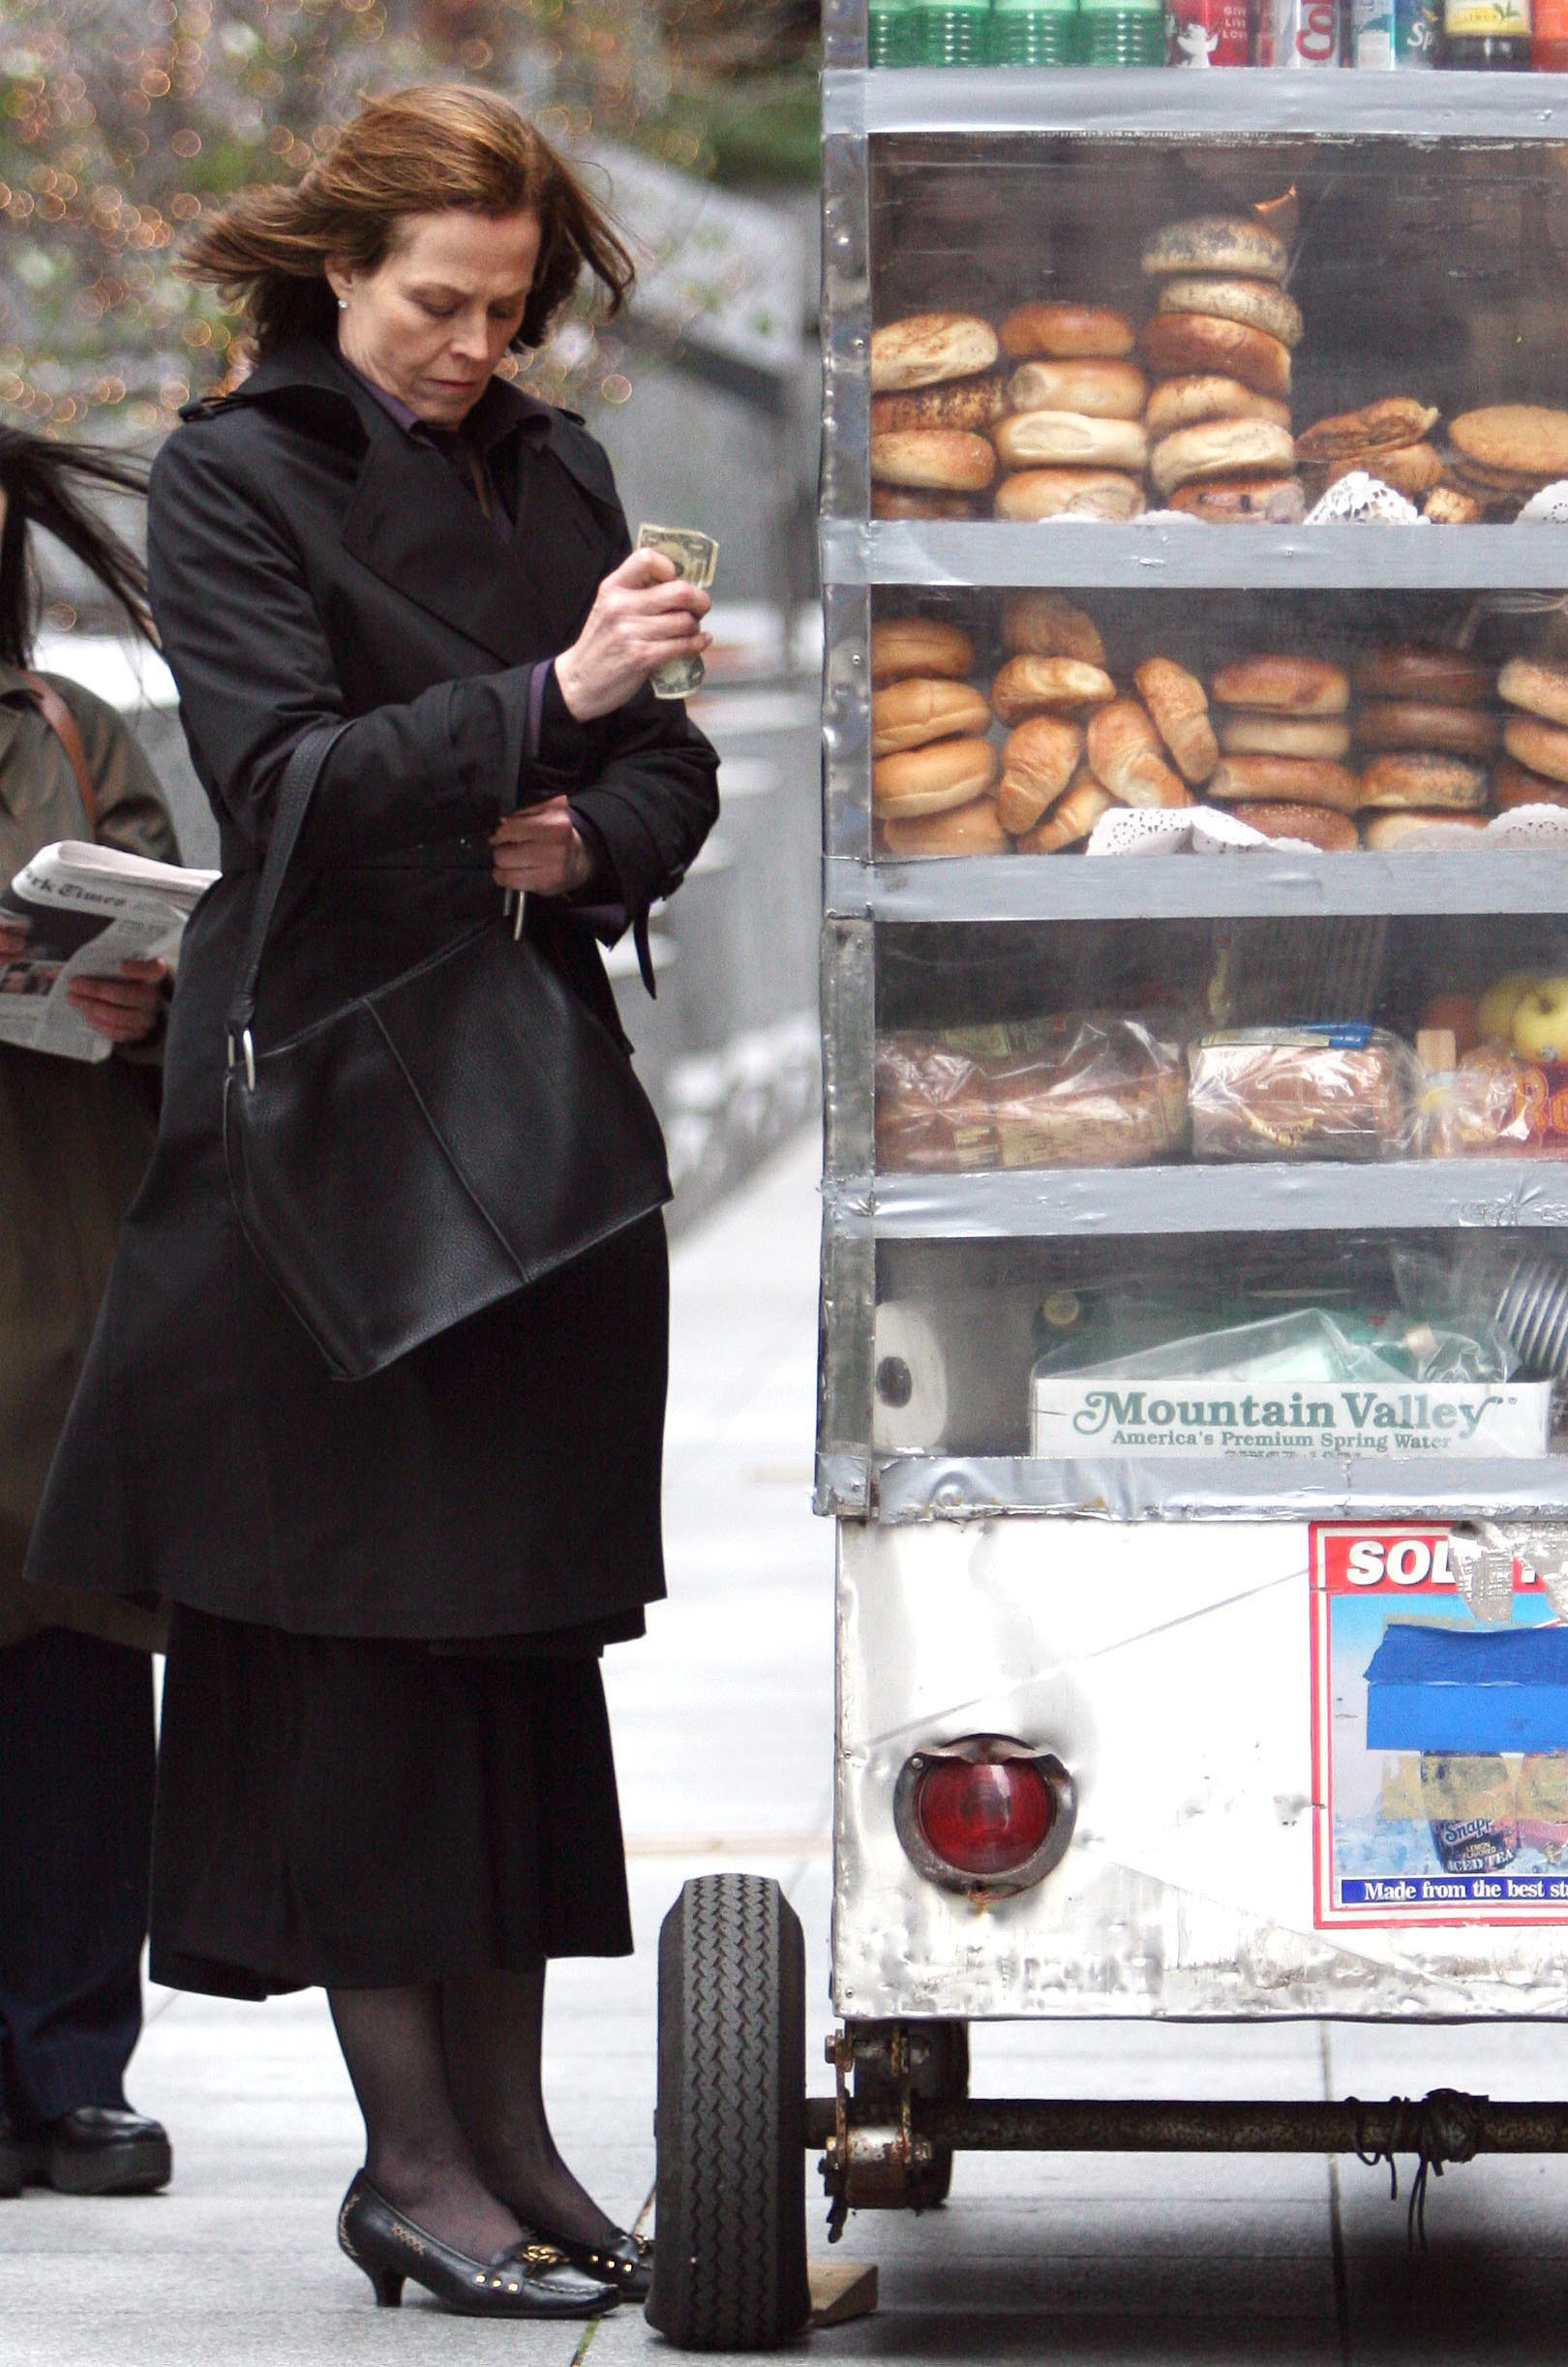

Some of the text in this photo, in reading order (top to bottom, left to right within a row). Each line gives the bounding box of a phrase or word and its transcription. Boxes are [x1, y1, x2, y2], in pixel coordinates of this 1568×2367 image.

[1072, 1390, 1504, 1440] Mountain Valley
[1112, 1430, 1214, 1445] America's
[1221, 1431, 1312, 1447] Premium
[1321, 1433, 1388, 1452] Spring
[1346, 1539, 1456, 1585] SOL
[1447, 1849, 1514, 1871] ICED TEA
[1365, 1879, 1568, 1900] Made from the best st
